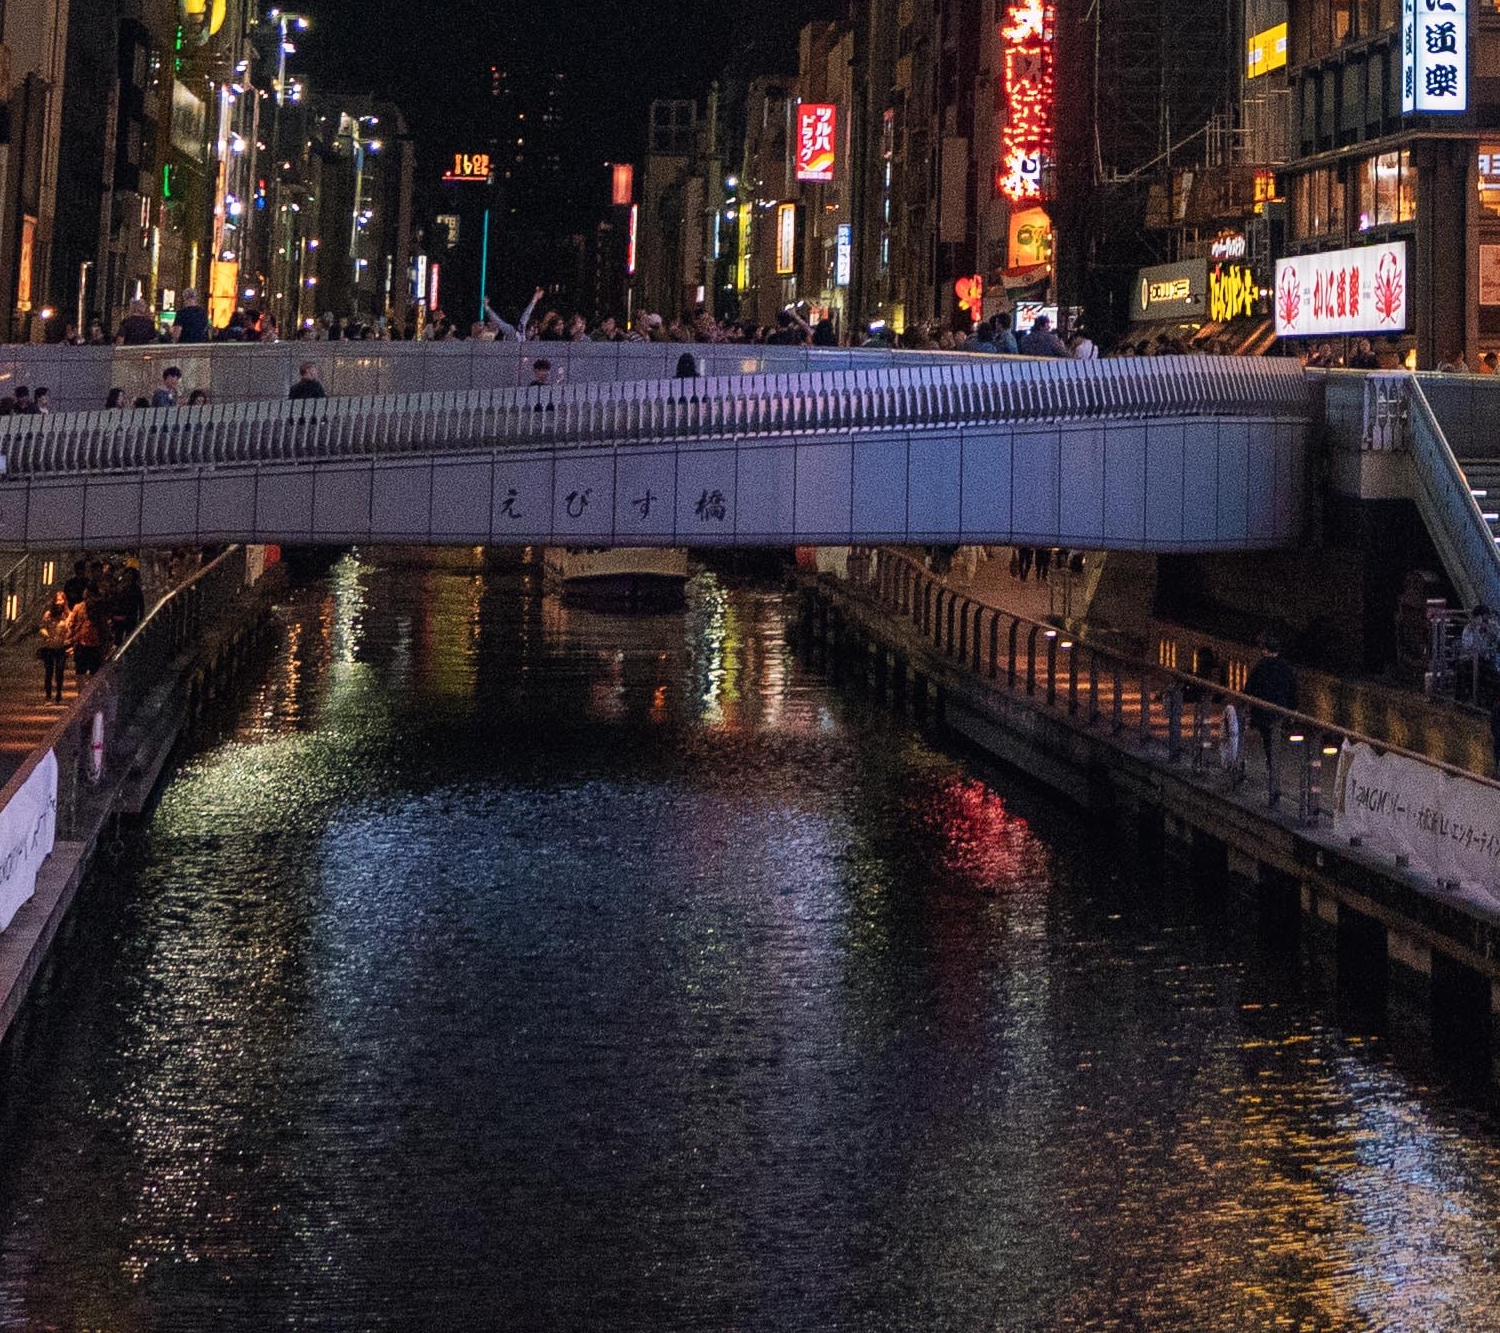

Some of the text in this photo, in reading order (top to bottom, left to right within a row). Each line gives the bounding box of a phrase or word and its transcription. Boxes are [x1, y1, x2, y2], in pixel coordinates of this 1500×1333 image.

[800, 114, 816, 161] ドラッグ
[815, 106, 833, 153] ツルハ
[501, 488, 726, 522] えびす橋
